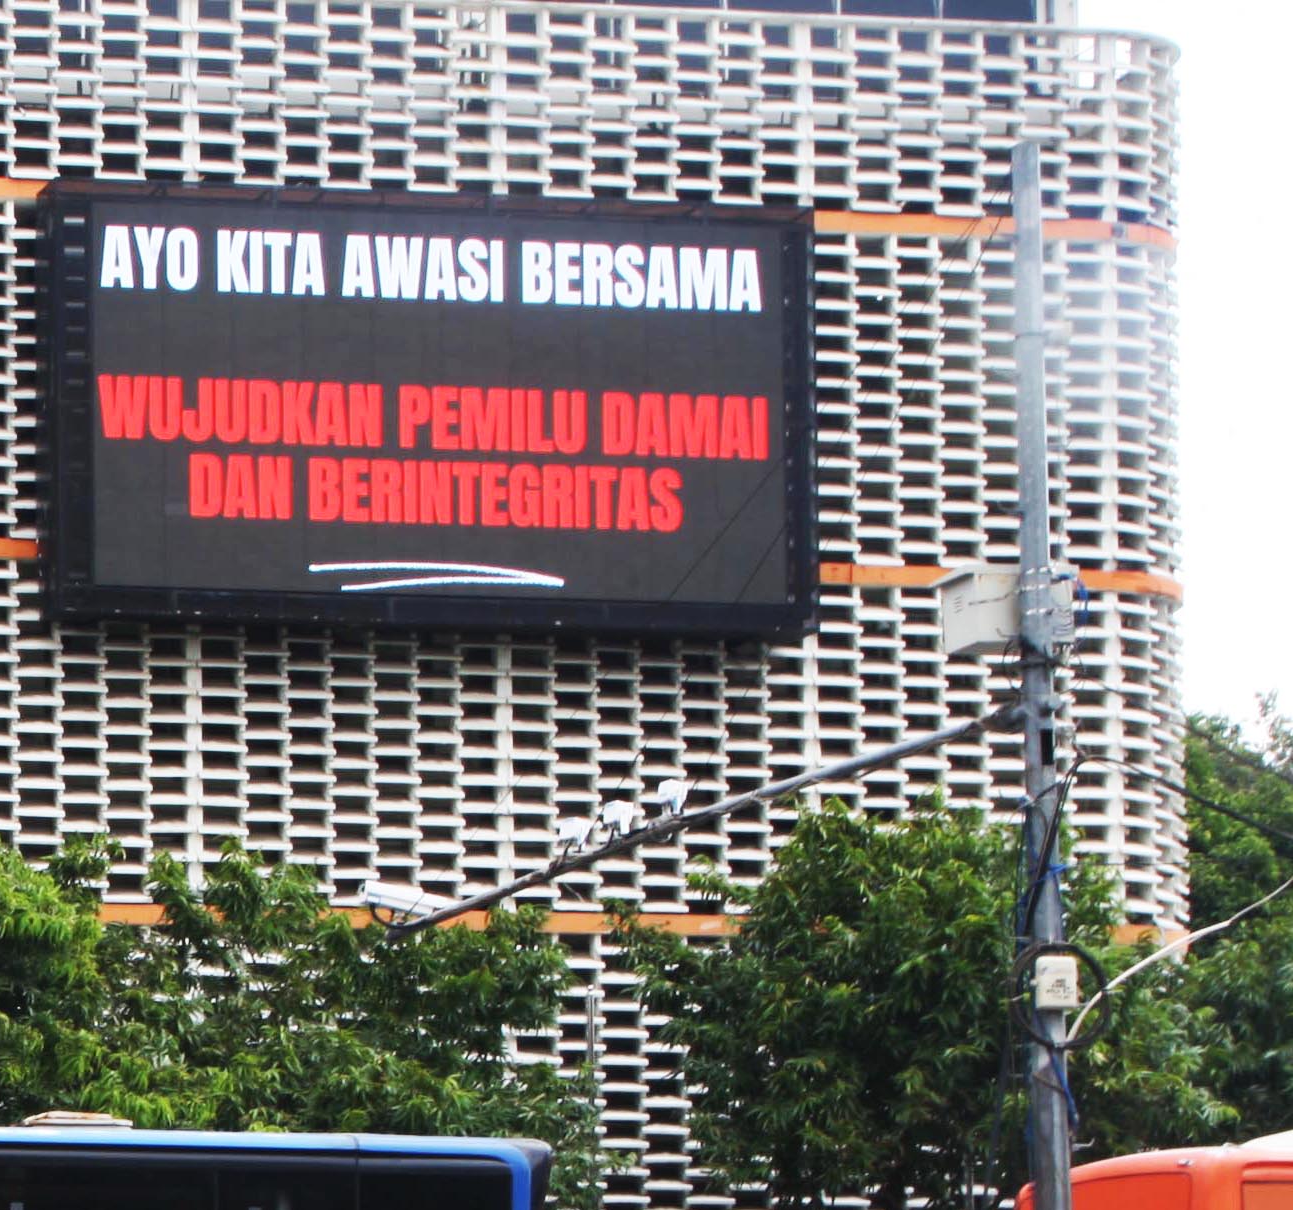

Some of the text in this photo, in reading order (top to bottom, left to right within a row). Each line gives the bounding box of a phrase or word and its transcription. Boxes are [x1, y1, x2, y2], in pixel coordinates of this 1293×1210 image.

[101, 225, 761, 312] AYO KITA AWASI BERSAMA
[98, 374, 769, 460] WUJUDKAN PEMILU DAMAI
[188, 454, 682, 532] DAN BERINTEGRITAS
